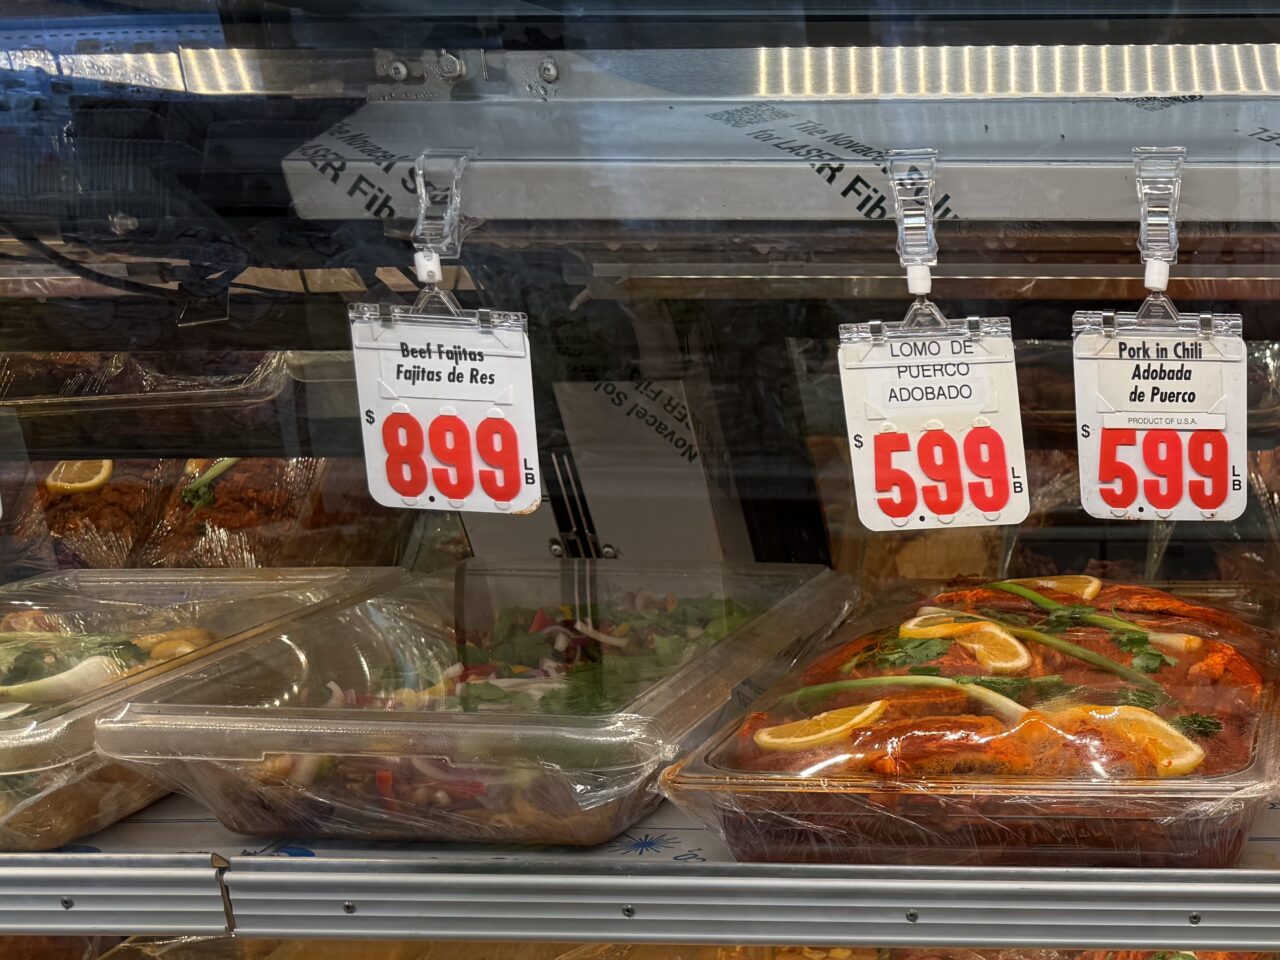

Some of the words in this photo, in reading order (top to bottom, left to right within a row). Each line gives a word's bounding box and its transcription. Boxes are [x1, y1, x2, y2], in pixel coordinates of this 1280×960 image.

[747, 129, 781, 142] for
[790, 119, 827, 136] The
[400, 342, 433, 358] Beef
[438, 343, 484, 365] Fajitas
[890, 341, 941, 357] LOMO
[951, 340, 974, 354] DE
[1119, 341, 1150, 359] Pork
[1156, 343, 1169, 359] in
[1174, 342, 1202, 359] Chili
[396, 364, 442, 385] Fajitas
[448, 367, 464, 383] de
[469, 368, 495, 385] Res
[897, 362, 969, 379] PUERCO
[1132, 364, 1192, 380] Adobada
[889, 385, 972, 402] ADOBADO
[1129, 385, 1145, 402] de
[1151, 387, 1195, 403] Puerco
[626, 403, 698, 463] Novacel
